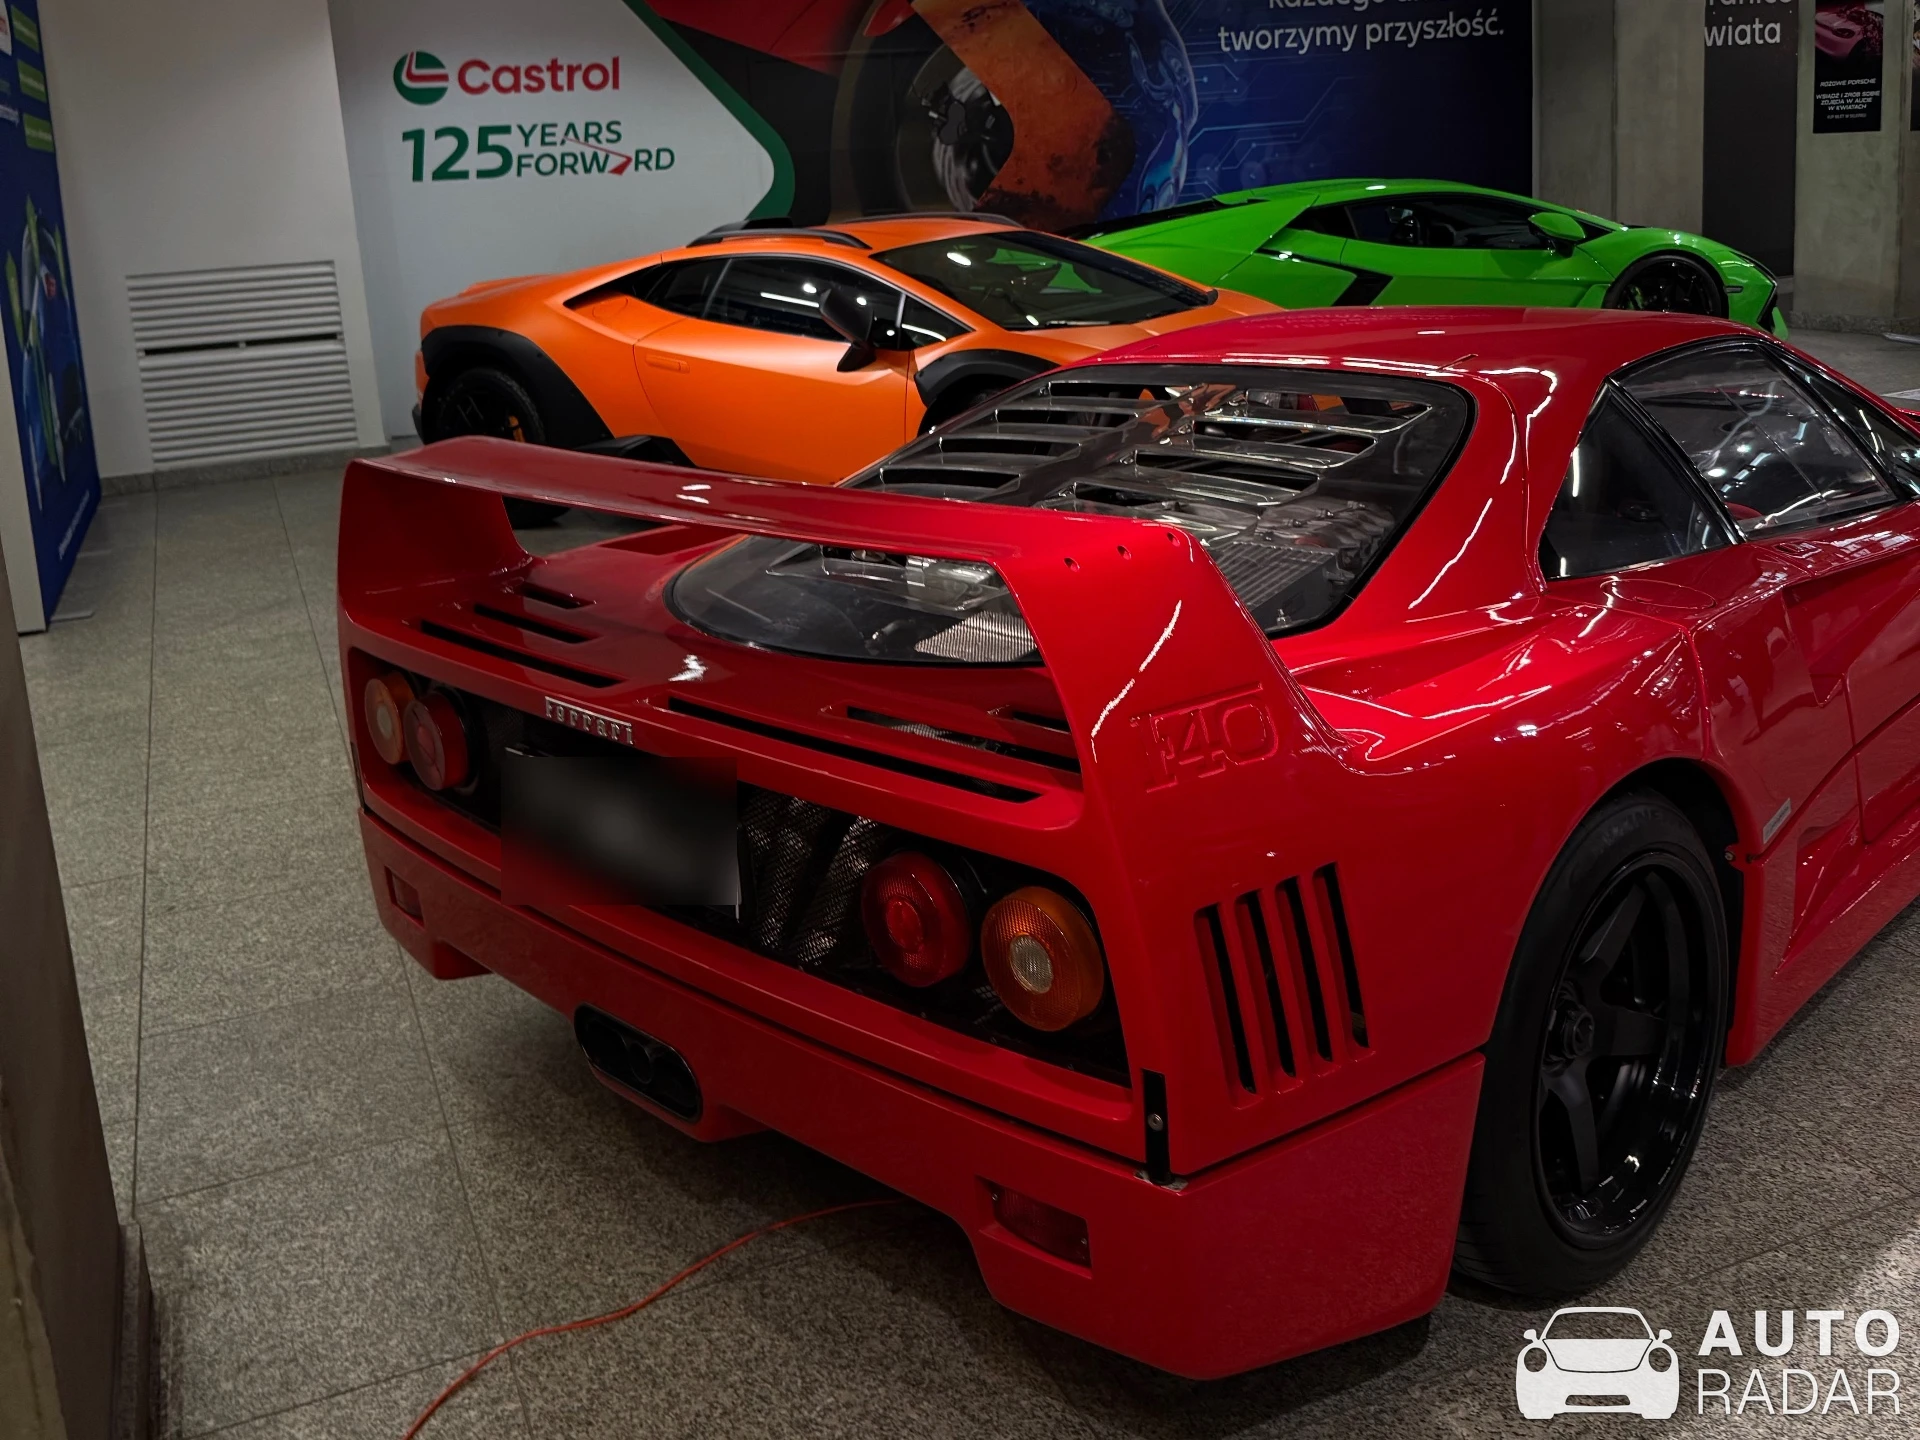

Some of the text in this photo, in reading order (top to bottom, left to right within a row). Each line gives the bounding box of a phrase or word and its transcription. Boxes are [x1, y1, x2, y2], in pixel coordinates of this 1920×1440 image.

[1218, 8, 1505, 55] tworzymy przyszłość.
[457, 56, 620, 96] Castrol
[402, 120, 623, 183] 125 YEARS
[1129, 680, 1279, 794] F40
